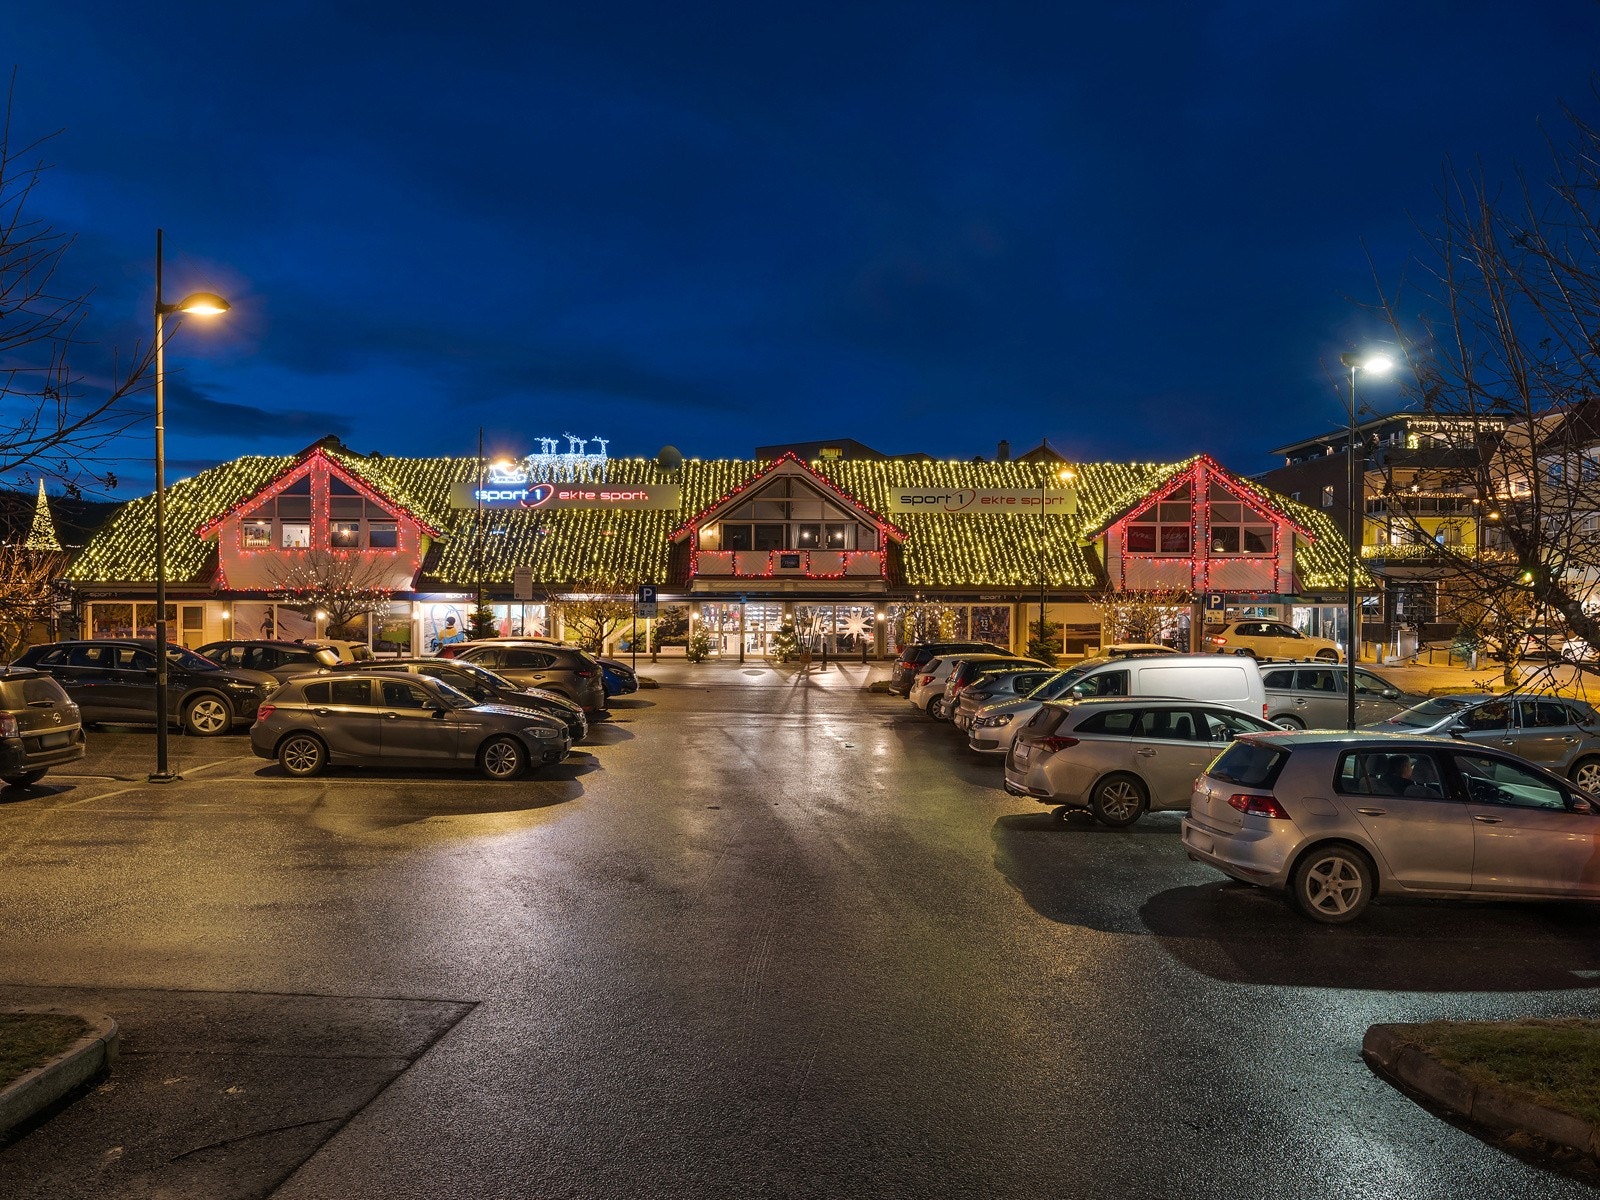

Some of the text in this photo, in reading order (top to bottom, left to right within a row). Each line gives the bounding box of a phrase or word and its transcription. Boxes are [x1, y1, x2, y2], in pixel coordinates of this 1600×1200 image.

[475, 488, 541, 502] sport 1
[559, 490, 596, 500] ekte
[900, 494, 964, 506] sport 1
[980, 495, 1016, 505] ekte
[643, 588, 653, 602] P
[1211, 595, 1221, 608] P
